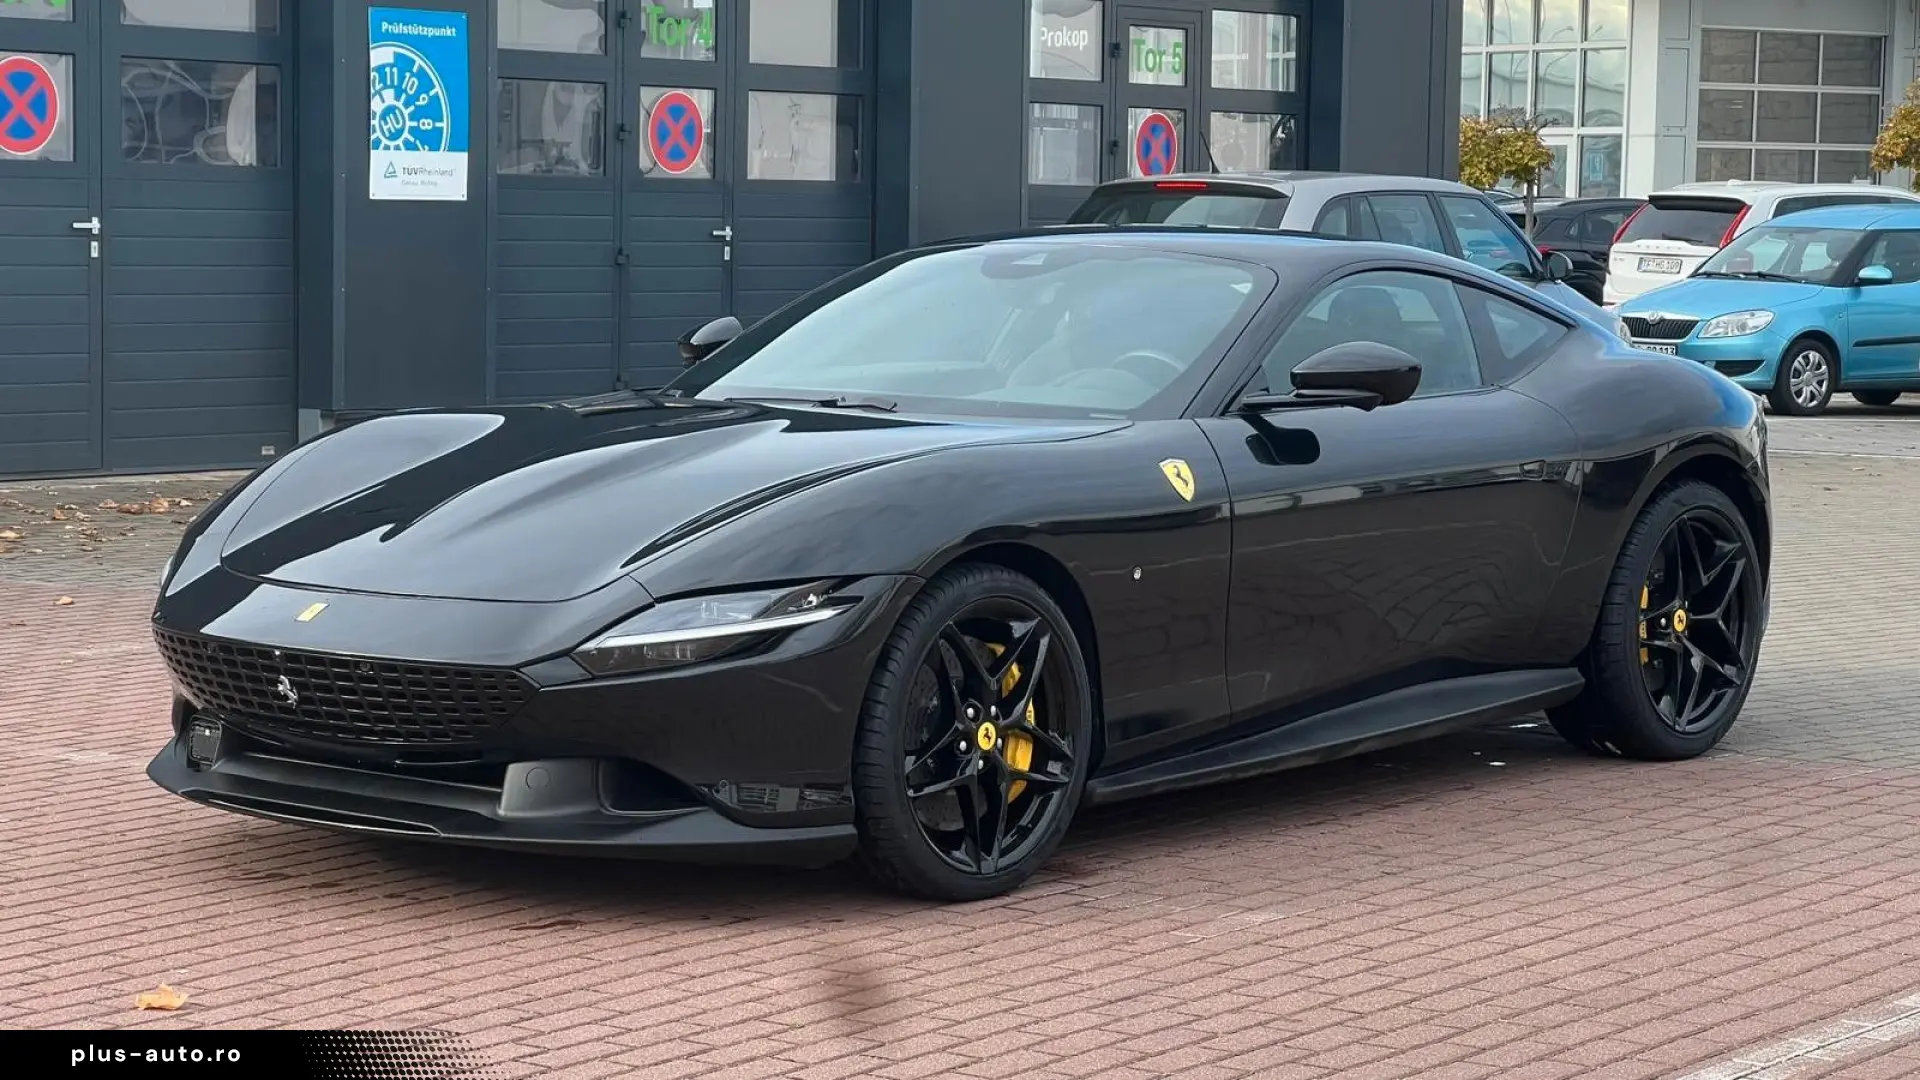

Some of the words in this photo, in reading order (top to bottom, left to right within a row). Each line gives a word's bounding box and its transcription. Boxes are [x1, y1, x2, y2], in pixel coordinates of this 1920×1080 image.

[381, 20, 457, 38] Prüfstützpunkt
[647, 5, 690, 47] Tor
[695, 8, 712, 49] 4
[1039, 25, 1089, 51] Prokop
[1132, 38, 1166, 73] Tor
[1171, 41, 1182, 74] 5
[371, 71, 384, 91] 2
[385, 66, 398, 86] 11
[402, 72, 418, 95] 10
[419, 118, 433, 131] 8
[381, 109, 403, 137] HU
